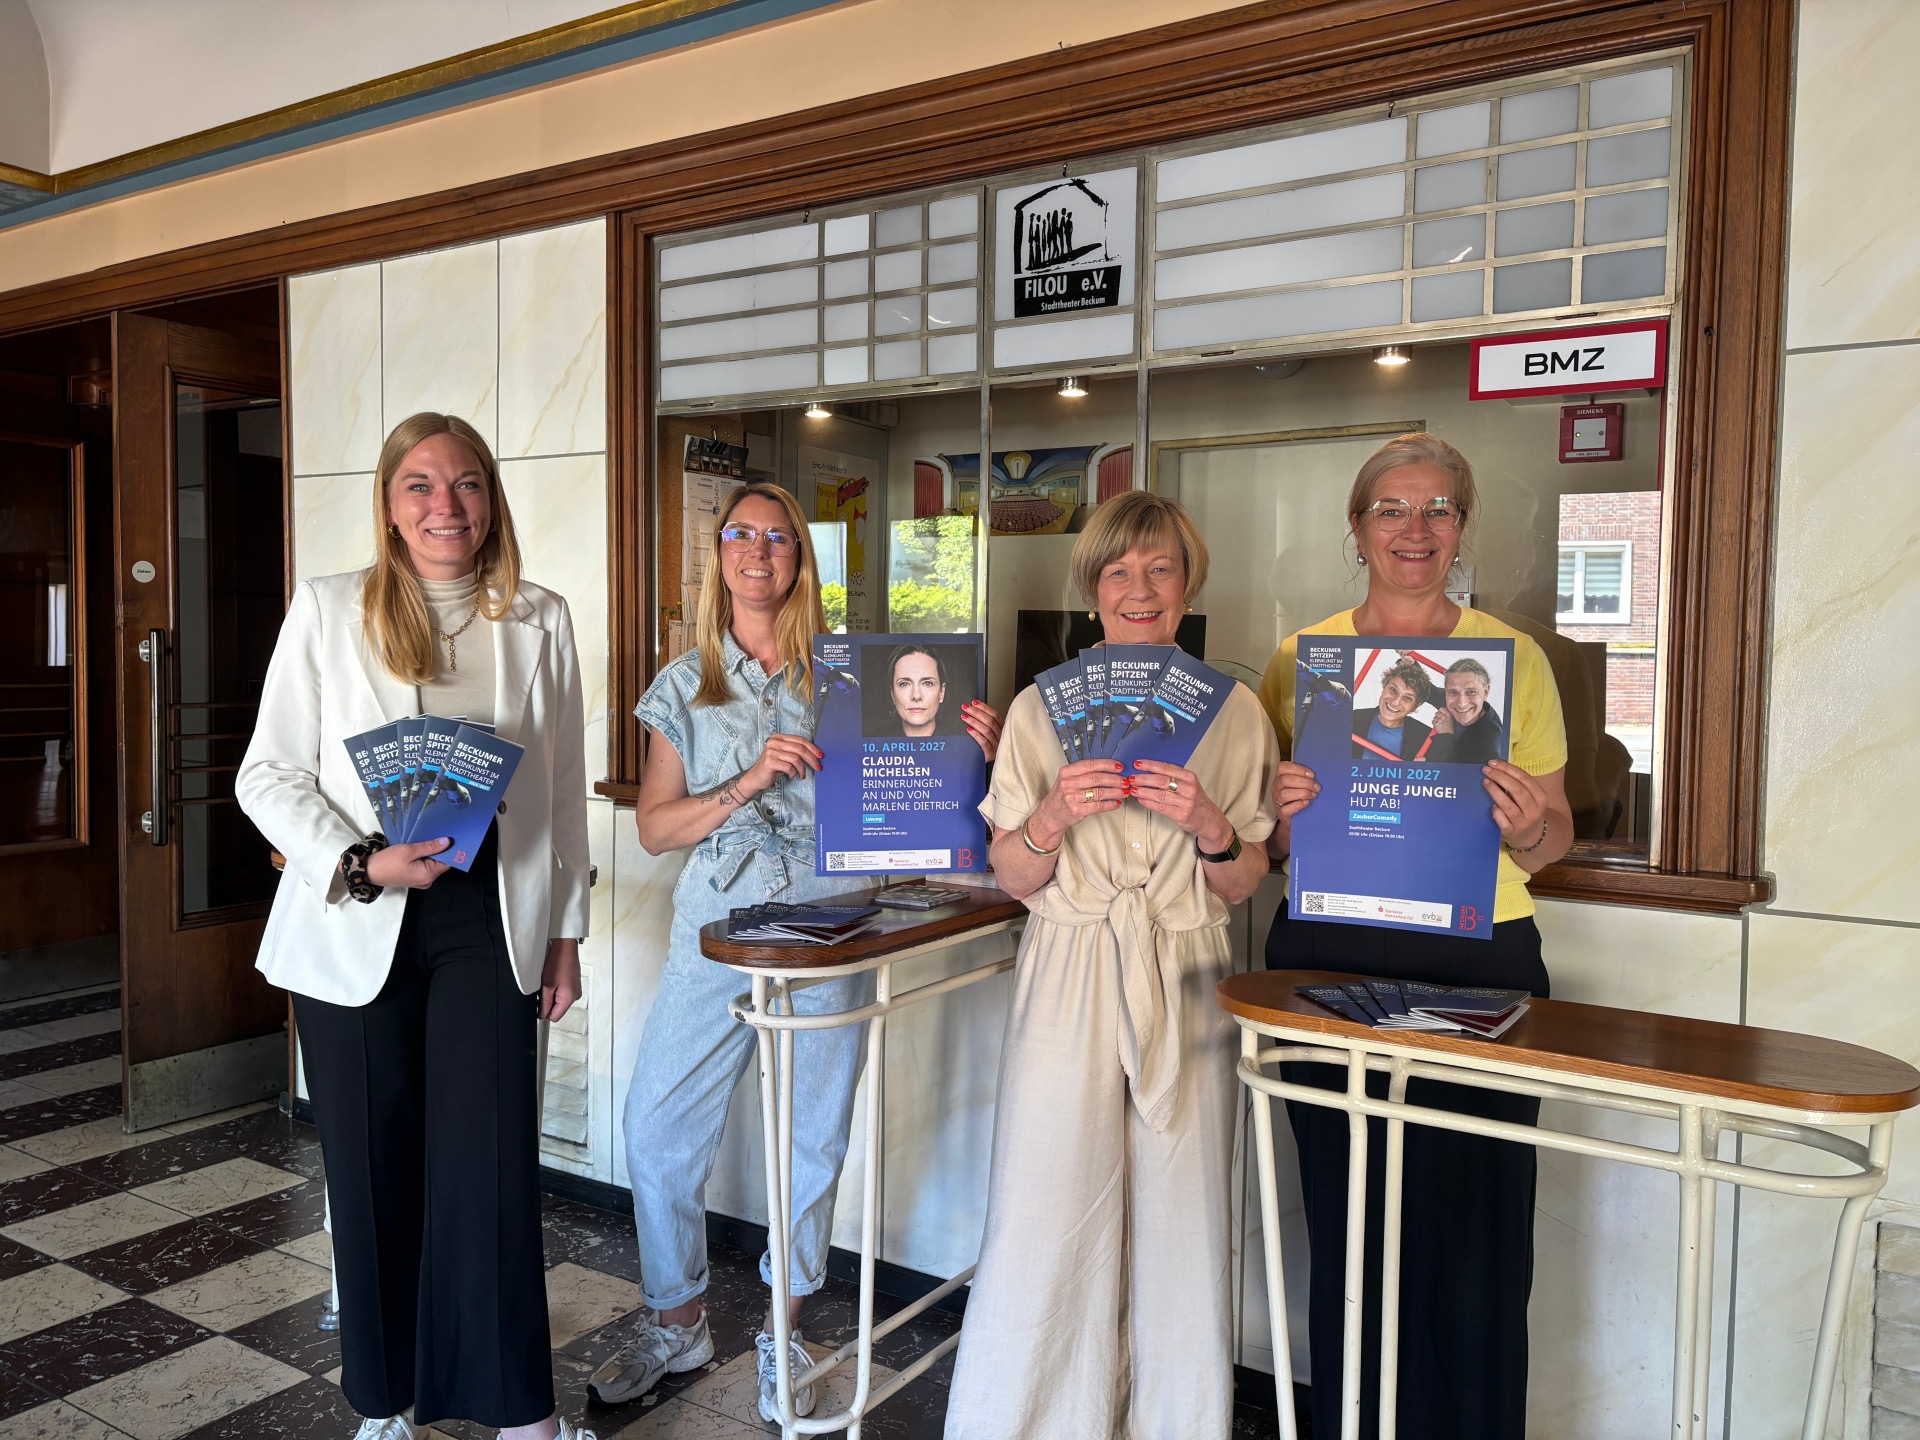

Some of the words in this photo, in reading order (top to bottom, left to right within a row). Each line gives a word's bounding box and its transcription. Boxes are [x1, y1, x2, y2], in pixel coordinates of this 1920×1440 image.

[1024, 275, 1068, 298] FILOU
[1082, 270, 1108, 291] e.V.
[1041, 300, 1080, 312] Stadttheater
[1081, 296, 1106, 306] Beckum
[1524, 346, 1605, 376] BMZ
[1111, 661, 1160, 670] BECKUMER
[1110, 670, 1148, 678] SPITZEN
[1170, 666, 1214, 695] BECKUMER
[1165, 674, 1199, 697] SPITZEN
[1157, 689, 1201, 717] STADTTHEATER
[1161, 682, 1198, 706] KLEINKUNST
[1197, 702, 1208, 711] IM
[457, 741, 503, 765] BECKUMER
[862, 743, 878, 752] 10.
[882, 742, 916, 752] APRIL
[920, 742, 946, 751] 2027
[450, 757, 490, 776] KLEINKUNST
[454, 750, 490, 768] SPITZEN
[862, 756, 915, 766] CLAUDIA
[447, 764, 495, 786] STADTTHEATER
[862, 767, 930, 777] MICHELSEN
[1351, 766, 1363, 778] 2.
[1366, 767, 1403, 780] JUNI
[1406, 769, 1441, 781] 2027
[862, 778, 942, 788] ERINNERUNGEN
[1350, 782, 1399, 796] JUNGE
[1403, 785, 1457, 799] JUNGE!
[862, 790, 877, 800] AN
[881, 790, 904, 800] UND
[906, 790, 930, 800] VON
[1350, 796, 1377, 808] HUT
[1380, 798, 1400, 810] AB!
[862, 801, 910, 811] MARLENE
[913, 800, 959, 810] DIETRICH
[1353, 813, 1398, 822] ZauberComedy
